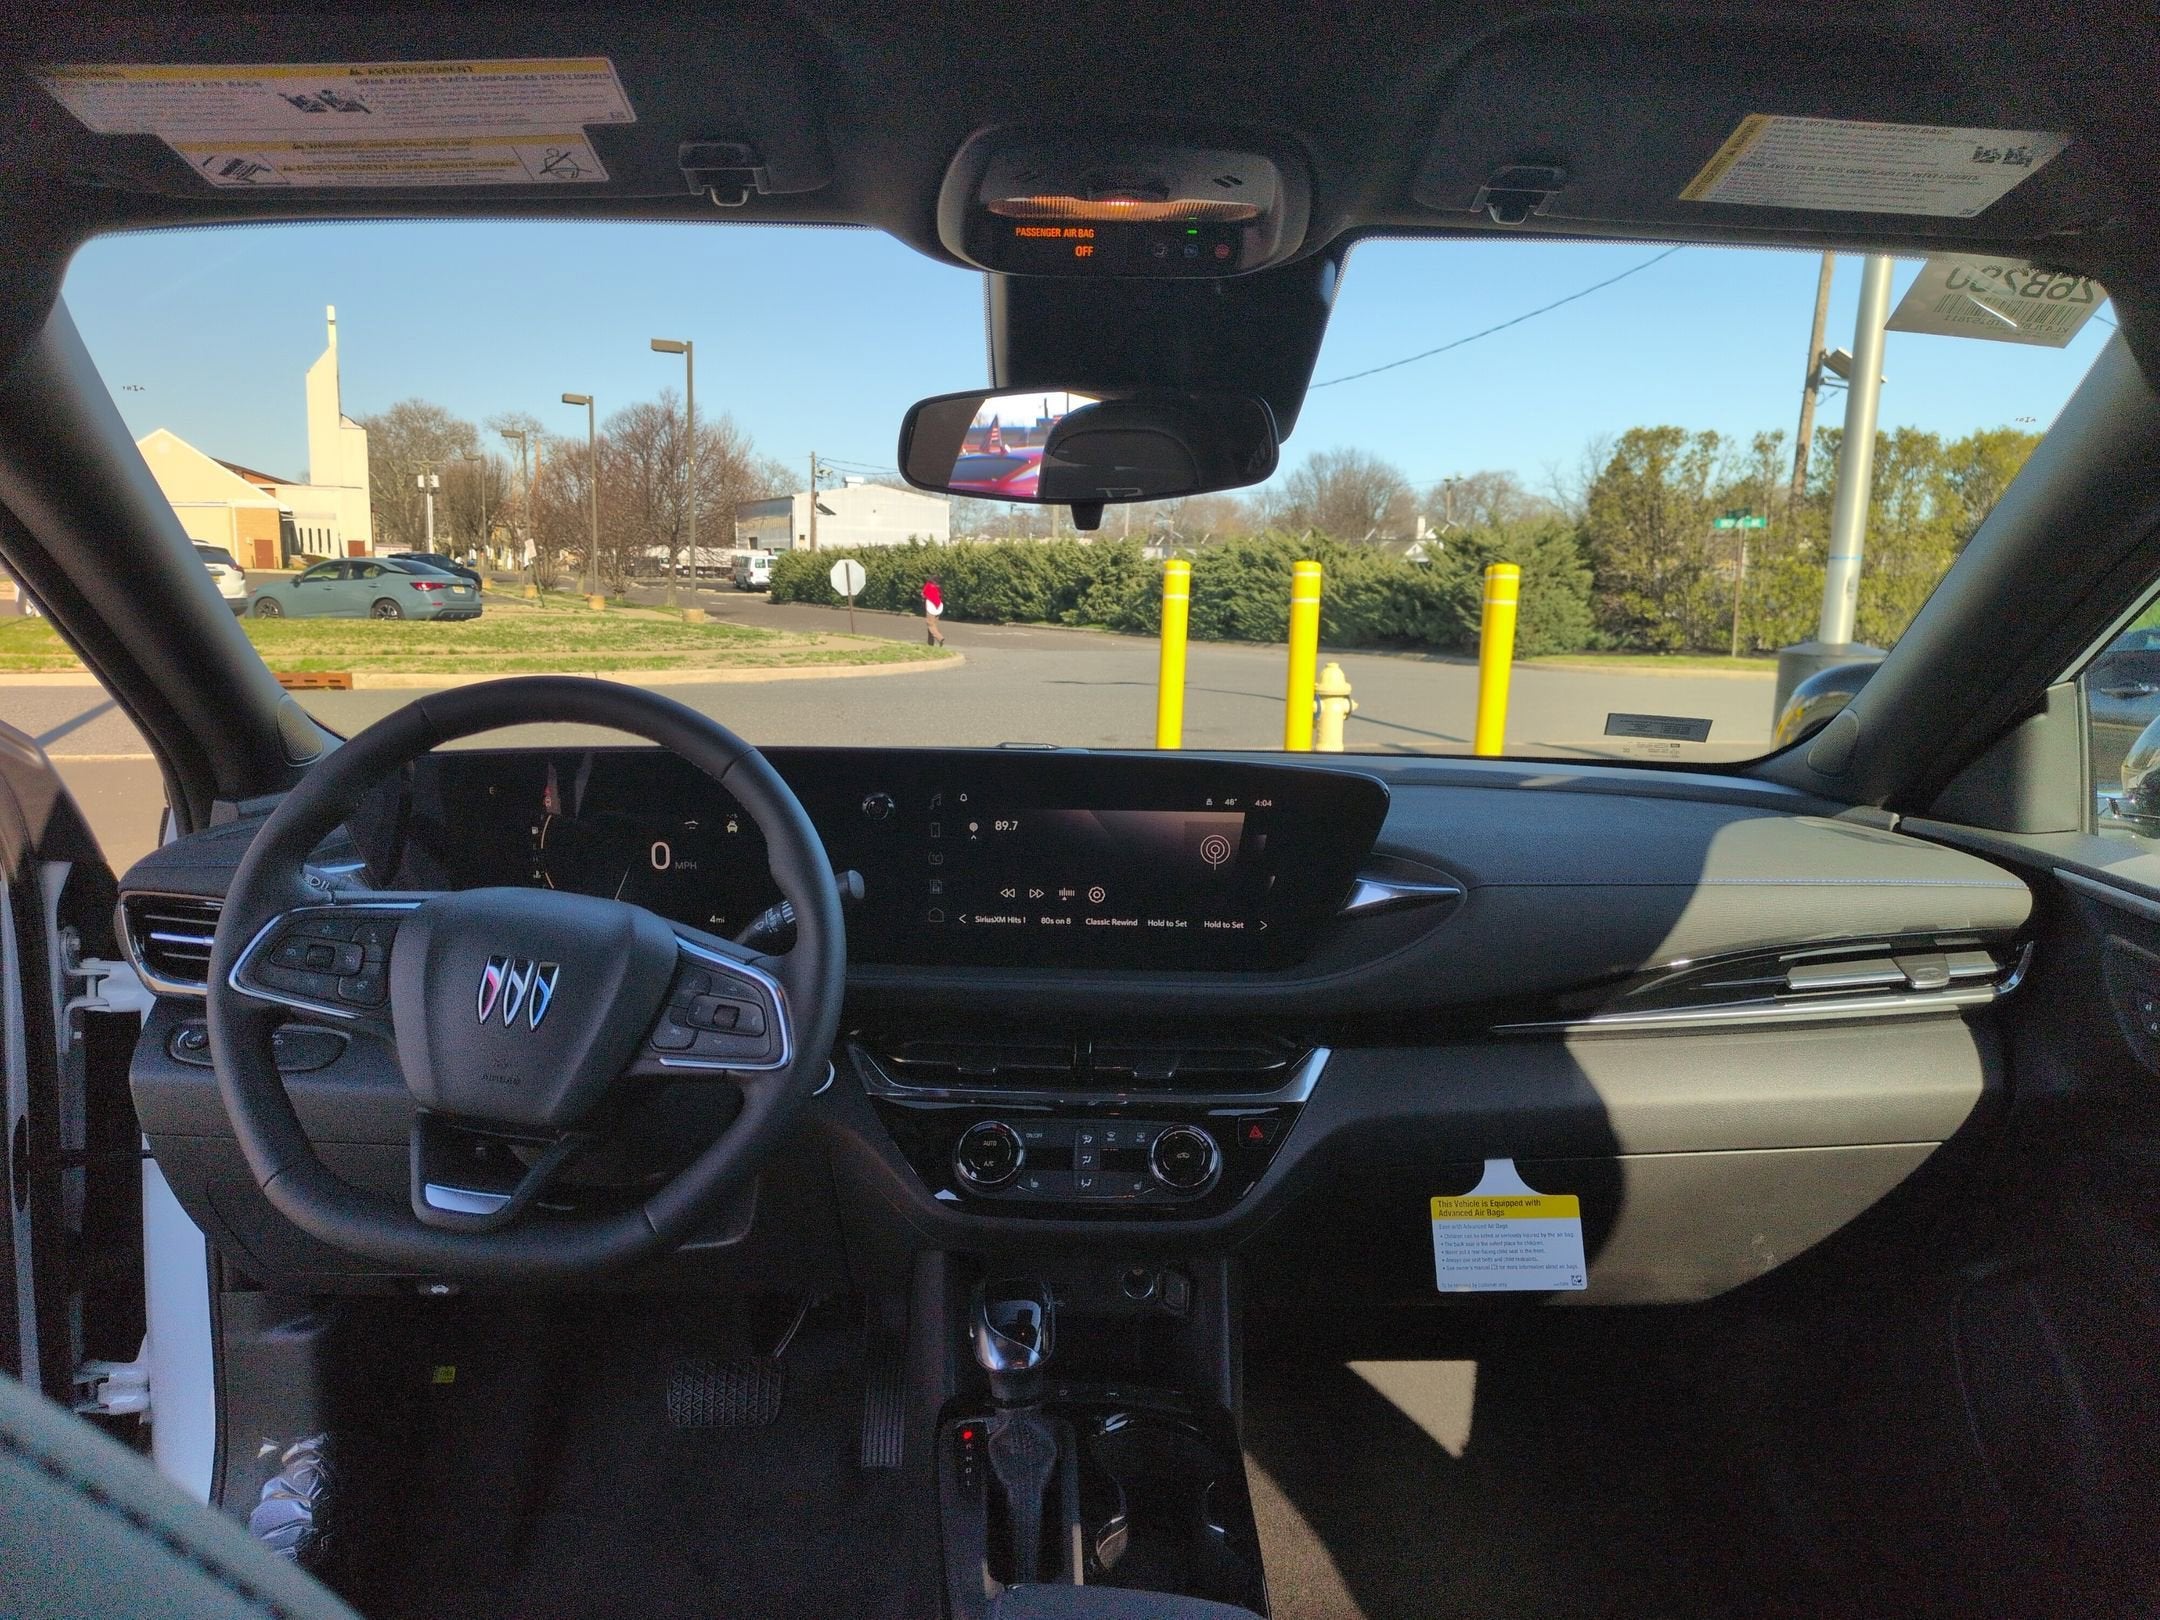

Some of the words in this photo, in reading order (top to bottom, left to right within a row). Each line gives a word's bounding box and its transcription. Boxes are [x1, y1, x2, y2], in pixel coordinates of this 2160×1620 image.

[1015, 227, 1061, 238] PASSENGER
[1063, 228, 1077, 238] AIR
[1078, 228, 1095, 238] BAG
[1075, 246, 1094, 257] OFF
[1254, 799, 1272, 807] 4:04
[995, 820, 1019, 831] 89.7
[651, 841, 671, 870] 0
[674, 861, 697, 870] MPH
[975, 915, 1006, 924] SiriusXM
[1007, 916, 1021, 924] Hits
[1066, 917, 1071, 925] 8
[1085, 918, 1110, 926] Classic
[1112, 918, 1138, 926] Rewind
[1148, 919, 1165, 927] Hold
[1175, 920, 1188, 928] Set
[1204, 920, 1222, 928] Hold
[1232, 921, 1244, 929] Set
[1438, 1199, 1452, 1208] This
[1454, 1199, 1480, 1208] Vehicle
[1482, 1199, 1489, 1207] is
[1490, 1199, 1523, 1208] Equipped
[1525, 1199, 1541, 1207] with
[1439, 1208, 1473, 1217] Advanced
[1475, 1208, 1486, 1216] Air
[1487, 1208, 1505, 1218] Bags
